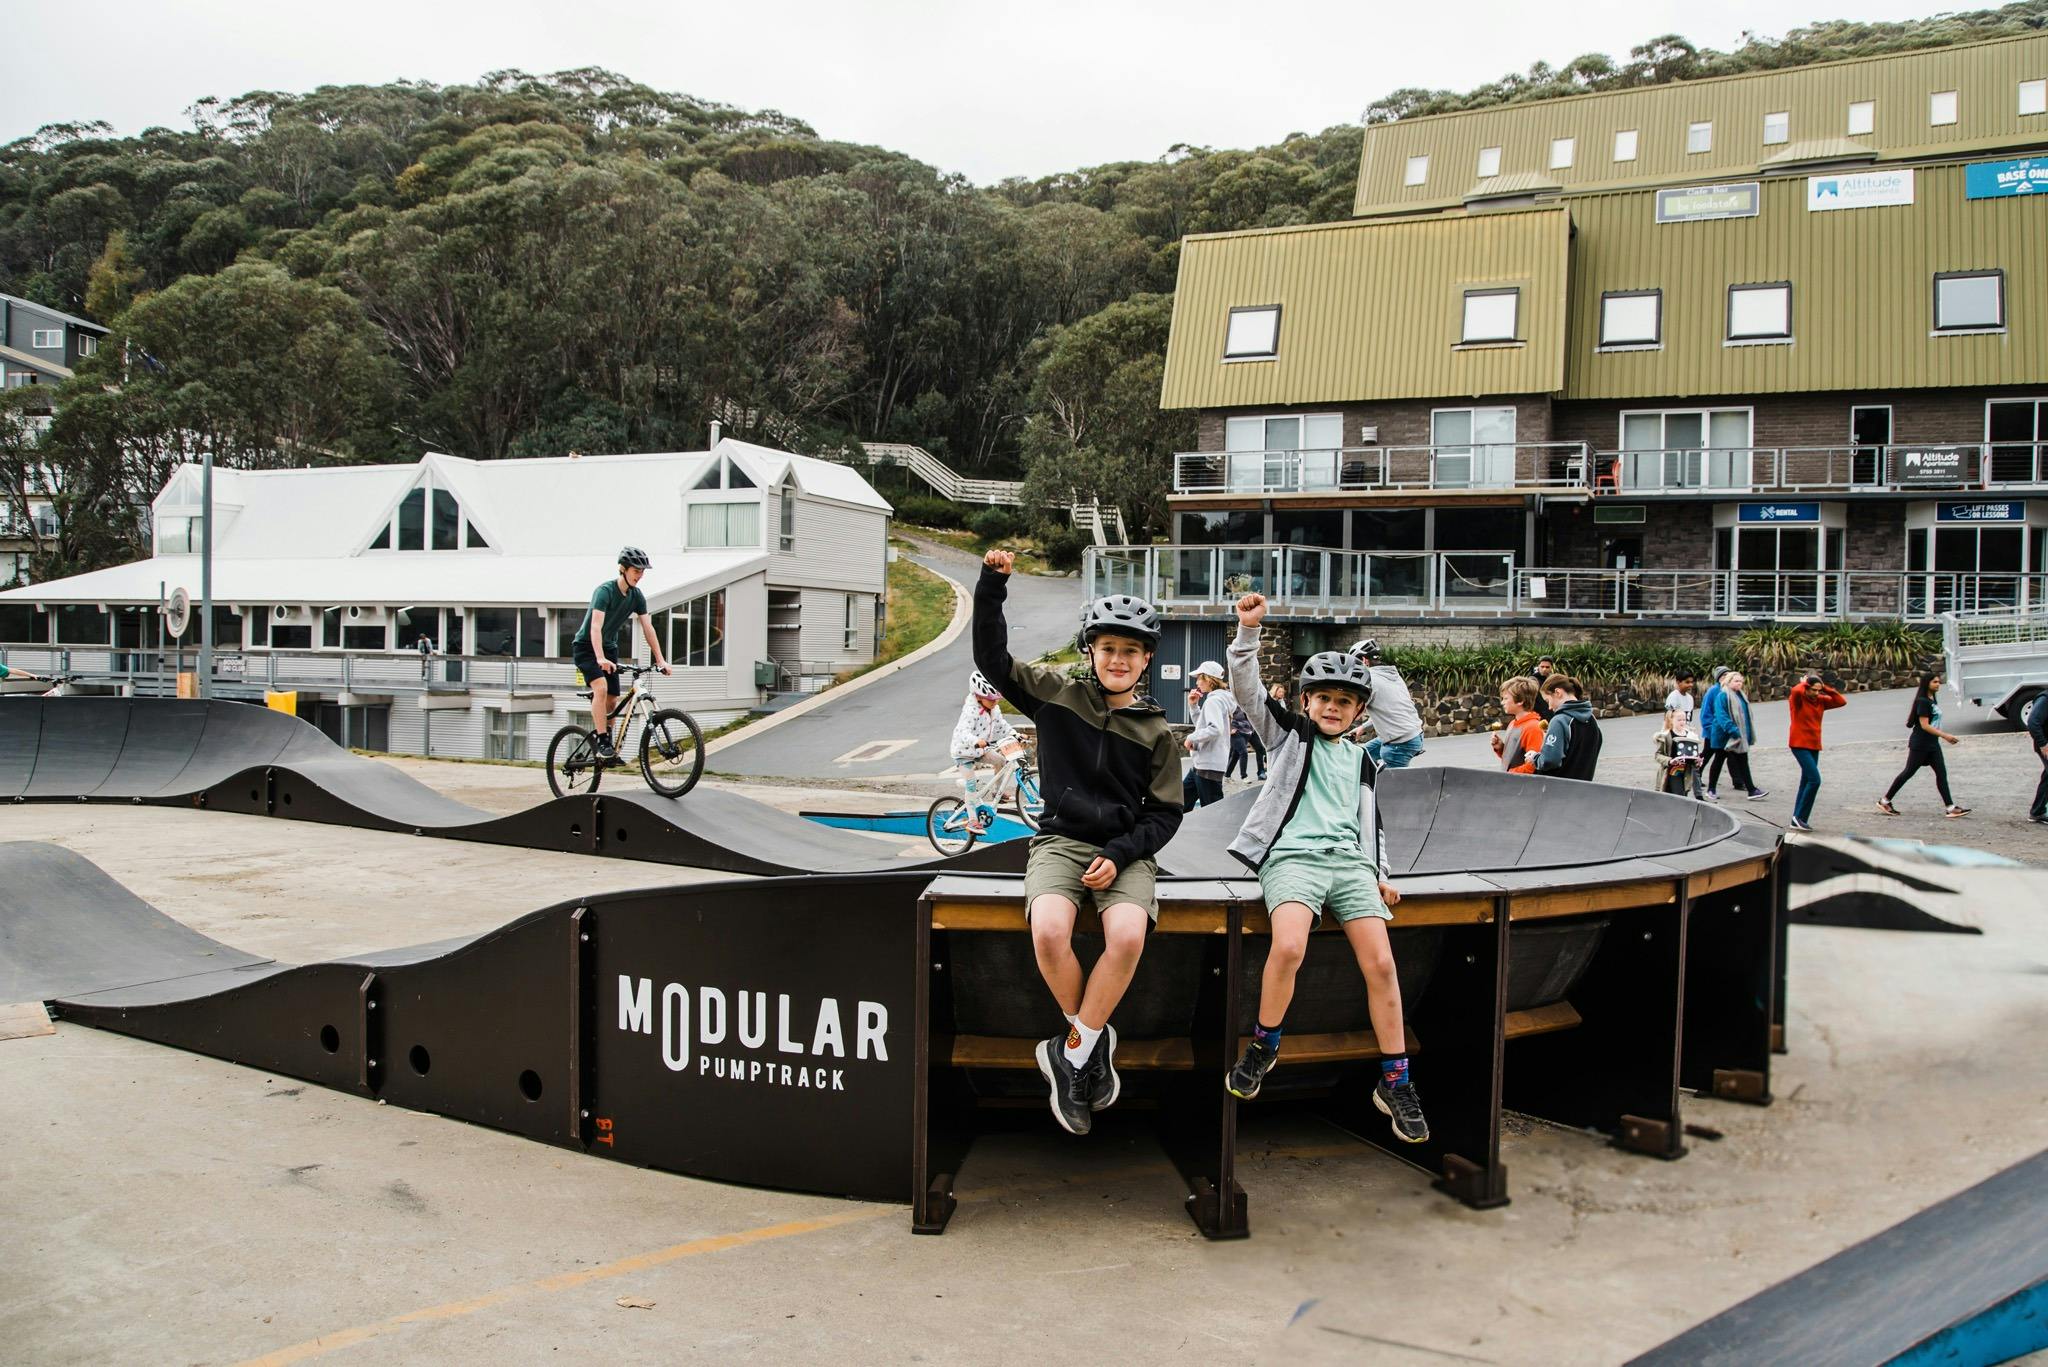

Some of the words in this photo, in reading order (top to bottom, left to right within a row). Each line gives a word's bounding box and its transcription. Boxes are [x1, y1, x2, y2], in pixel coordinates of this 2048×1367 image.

[1842, 176, 1902, 190] Altitude
[1997, 170, 2027, 183] BASE
[1922, 452, 1960, 461] Altitude
[618, 974, 889, 1072] MODULAR
[699, 1055, 845, 1091] PUMPTRACK
